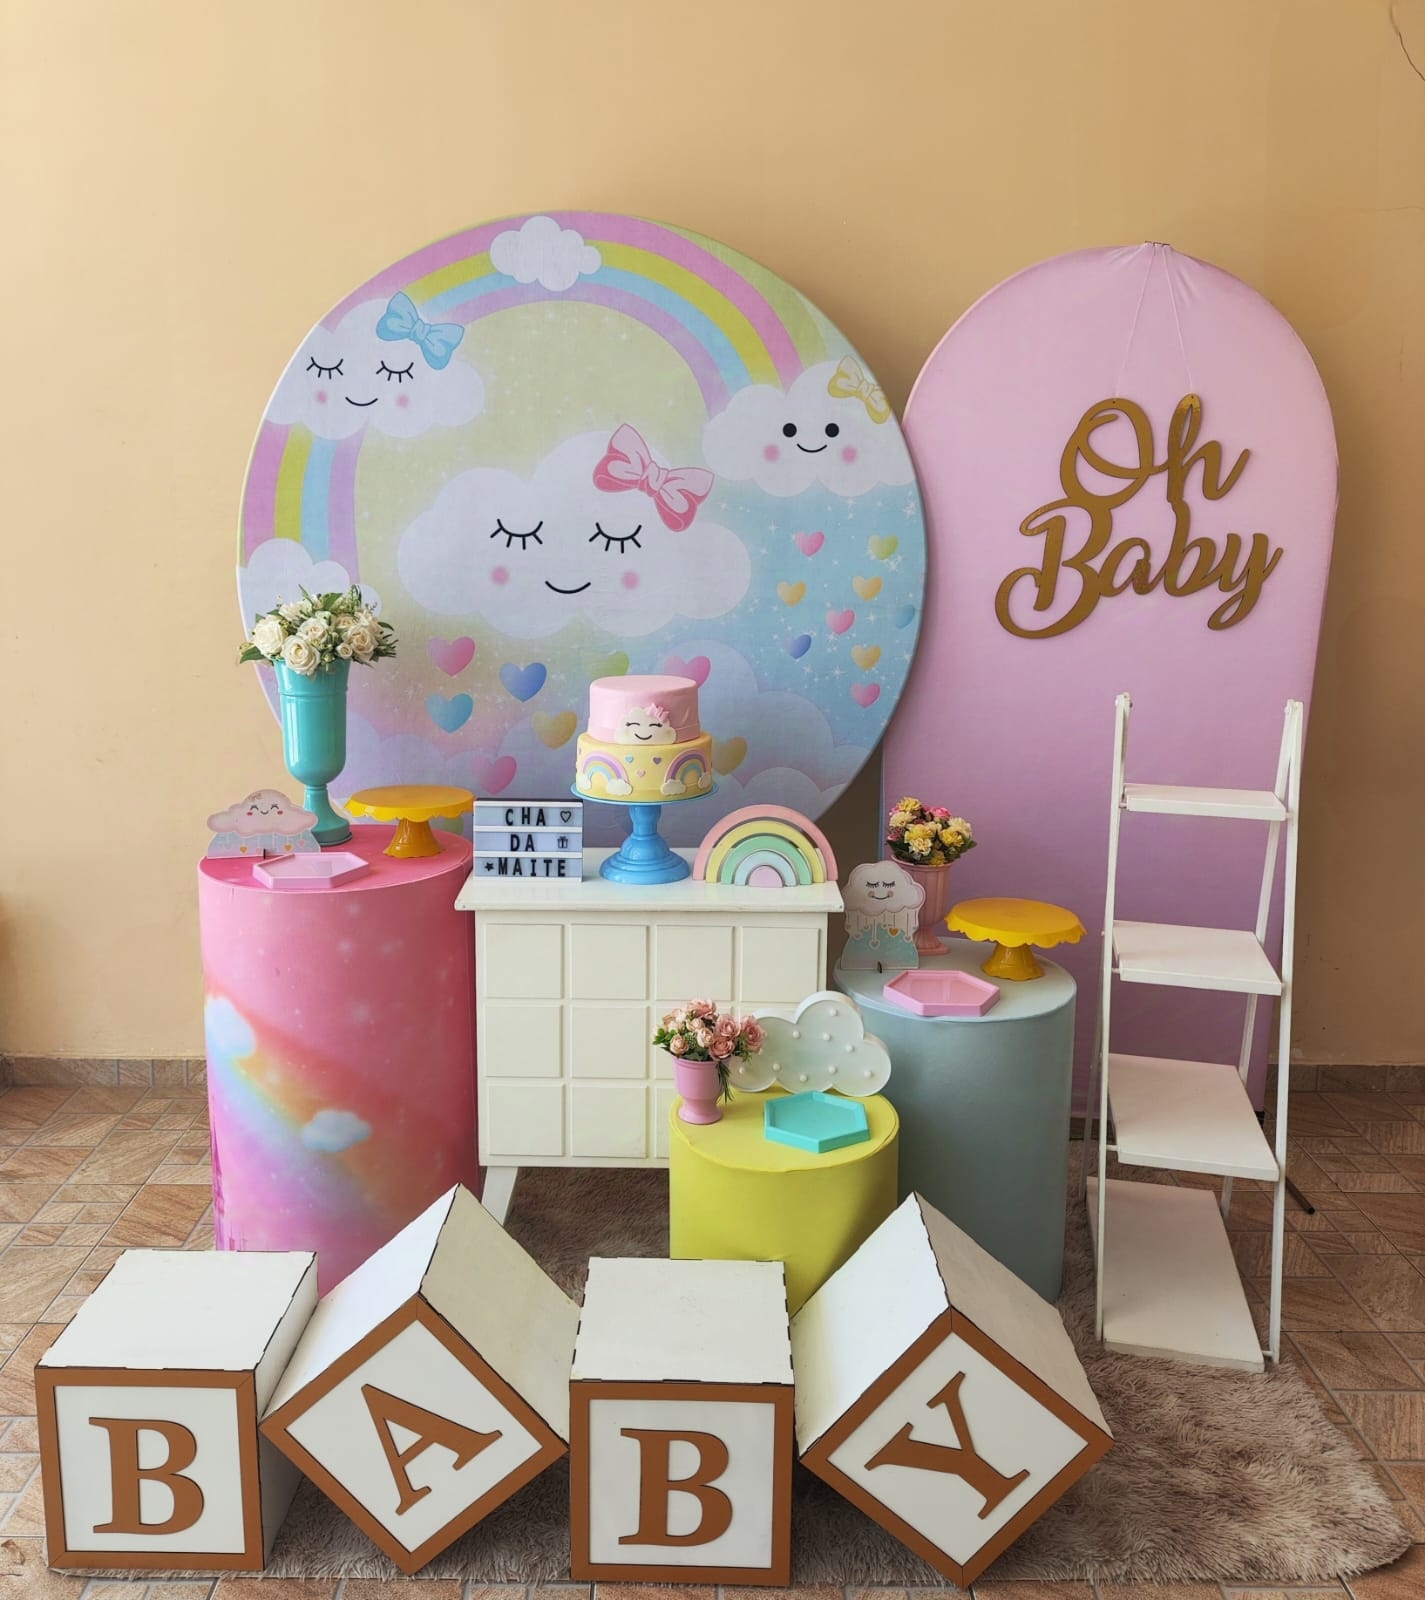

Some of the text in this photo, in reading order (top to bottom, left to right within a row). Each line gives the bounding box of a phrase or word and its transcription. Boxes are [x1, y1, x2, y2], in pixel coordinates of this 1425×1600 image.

[1060, 393, 1251, 510] Oh
[995, 497, 1284, 639] Baby
[505, 806, 546, 826] CHA
[510, 833, 535, 852] DA
[498, 857, 566, 877] MAITE
